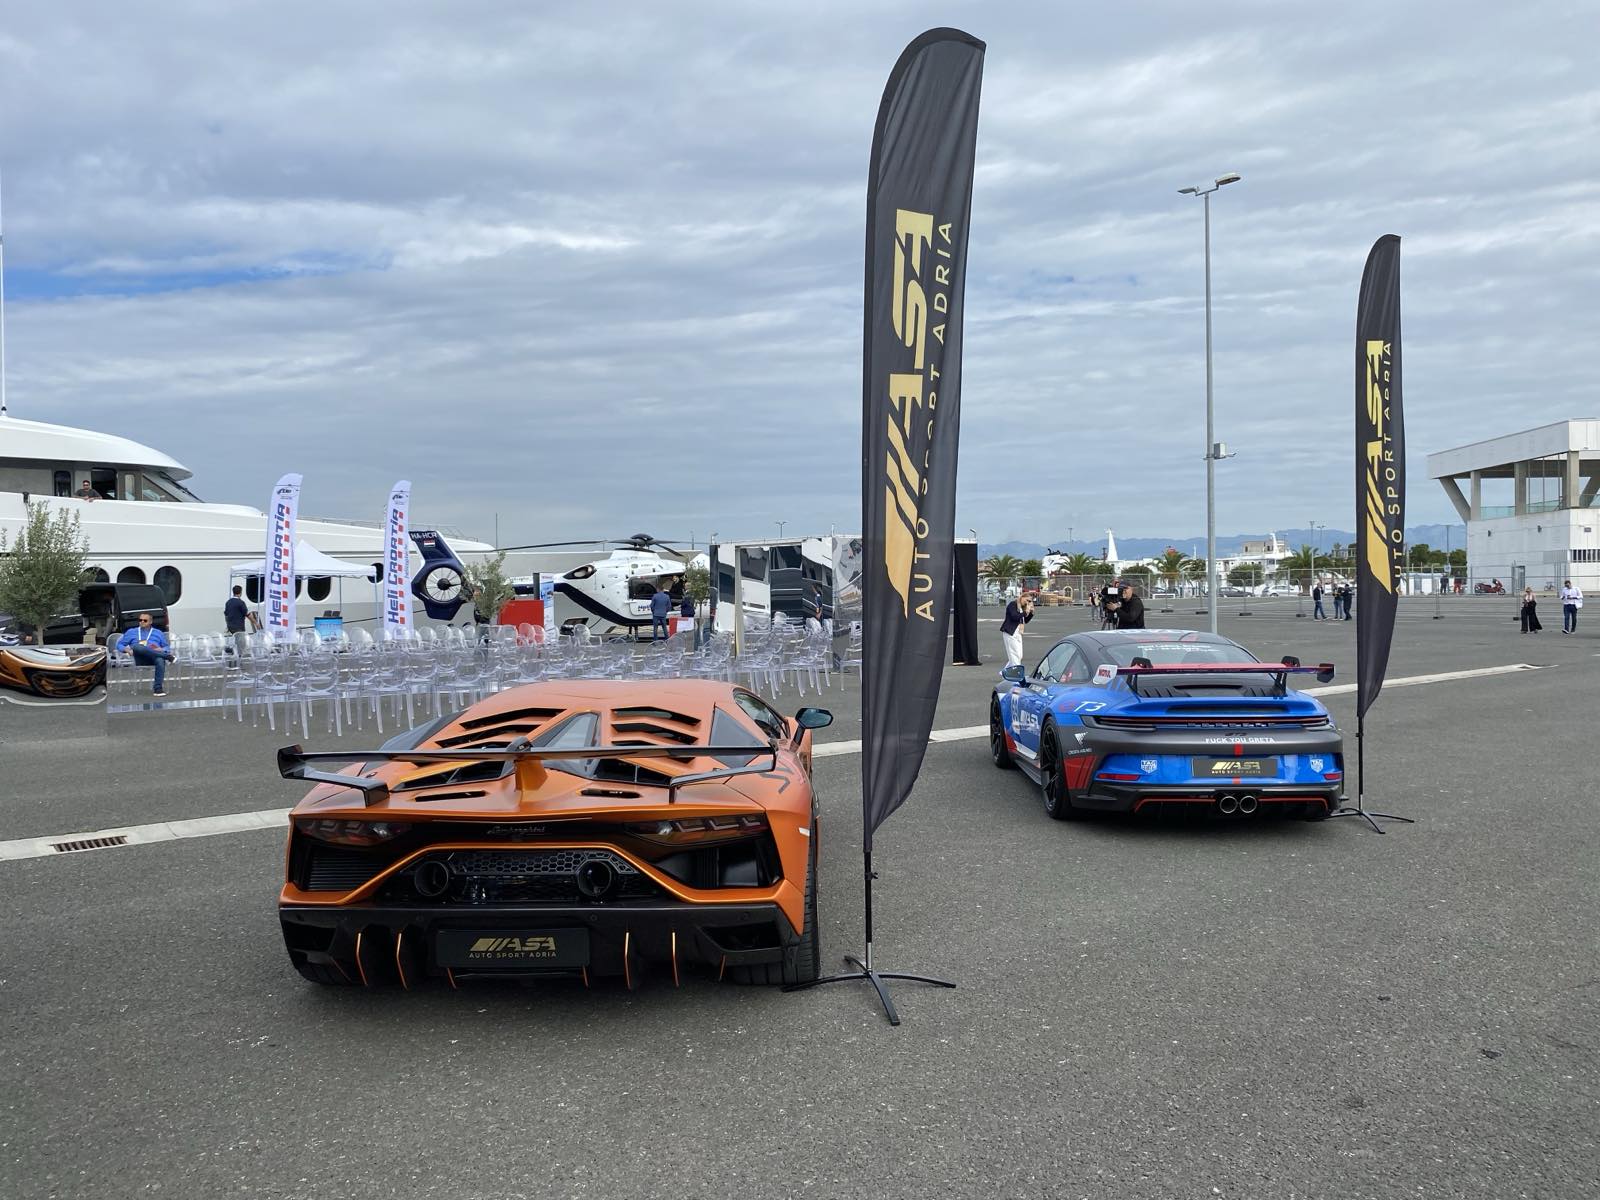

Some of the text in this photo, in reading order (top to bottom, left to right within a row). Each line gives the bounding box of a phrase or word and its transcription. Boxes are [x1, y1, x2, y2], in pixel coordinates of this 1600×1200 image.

[1383, 342, 1392, 421] ADRIA
[914, 517, 935, 621] AUTO
[932, 222, 952, 346] ADRIA
[1383, 432, 1400, 516] SPORT
[269, 588, 282, 627] Heli
[387, 588, 399, 625] Heli
